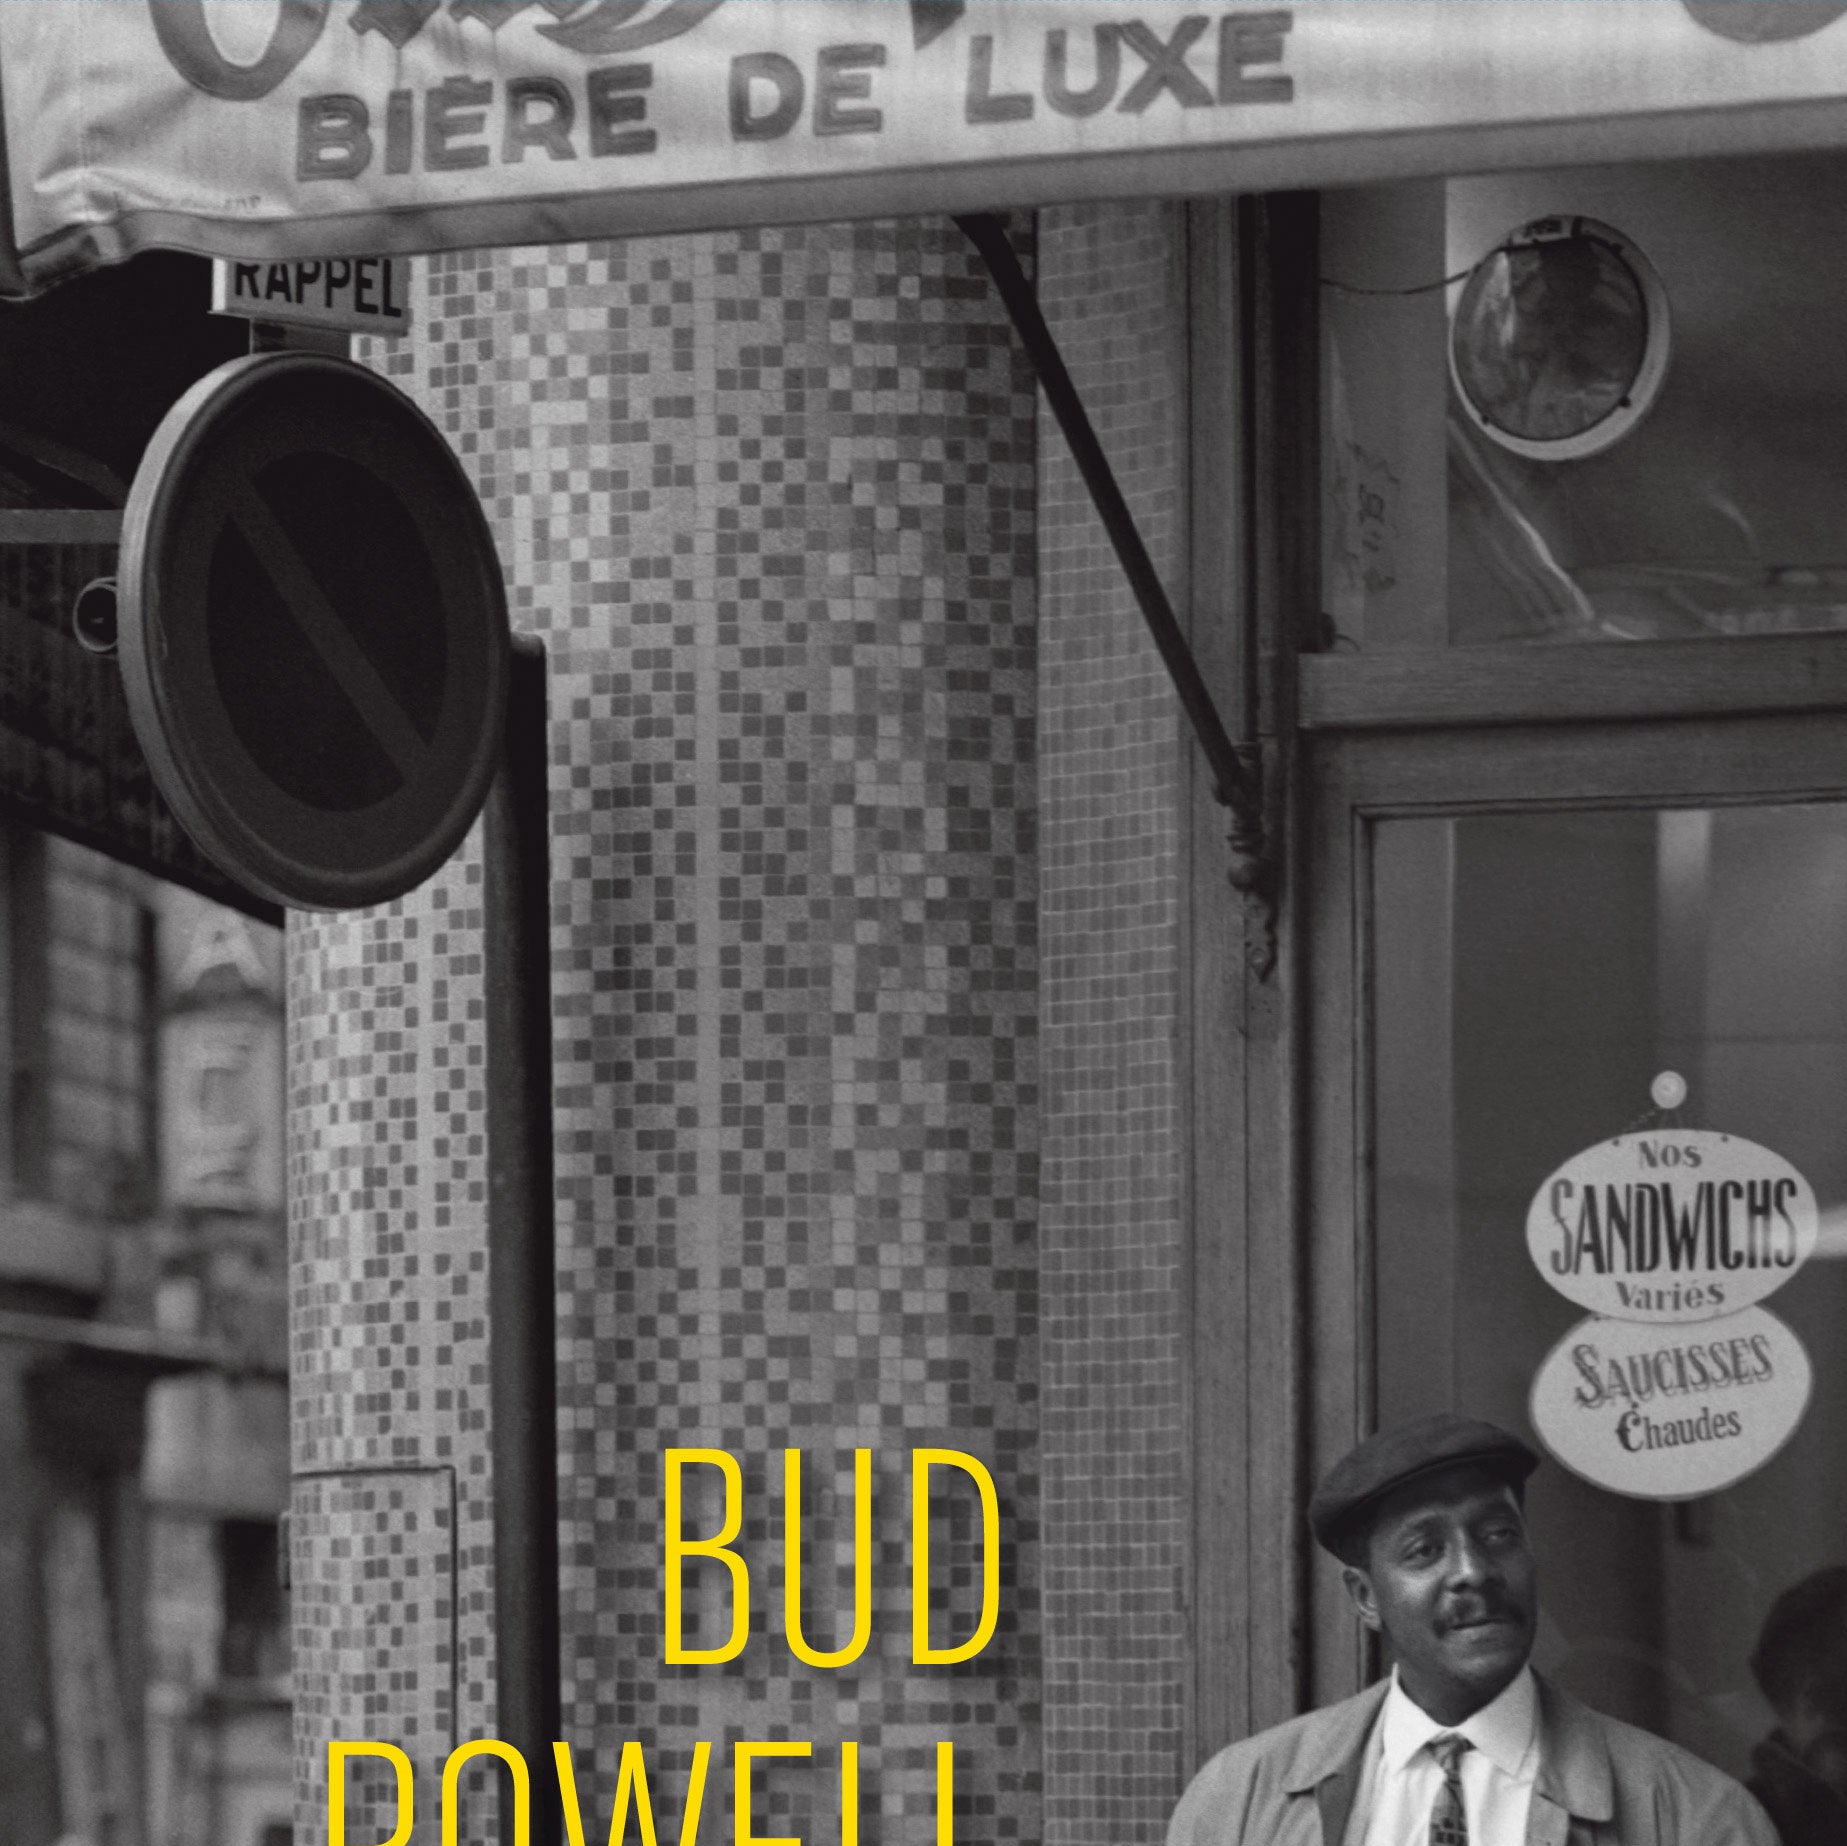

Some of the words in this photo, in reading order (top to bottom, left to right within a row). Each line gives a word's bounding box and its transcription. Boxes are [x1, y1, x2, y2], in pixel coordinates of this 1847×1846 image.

[295, 62, 658, 183] BIÈRE
[728, 44, 886, 143] DE
[964, 10, 1294, 126] LUXE
[233, 257, 402, 318] RAPPEL
[1637, 1139, 1701, 1169] Nos
[1550, 1177, 1798, 1276] SANDWICHS
[1616, 1280, 1725, 1312] Variés
[1571, 1333, 1774, 1409] SAUCISSES
[1614, 1401, 1741, 1453] Chaudes
